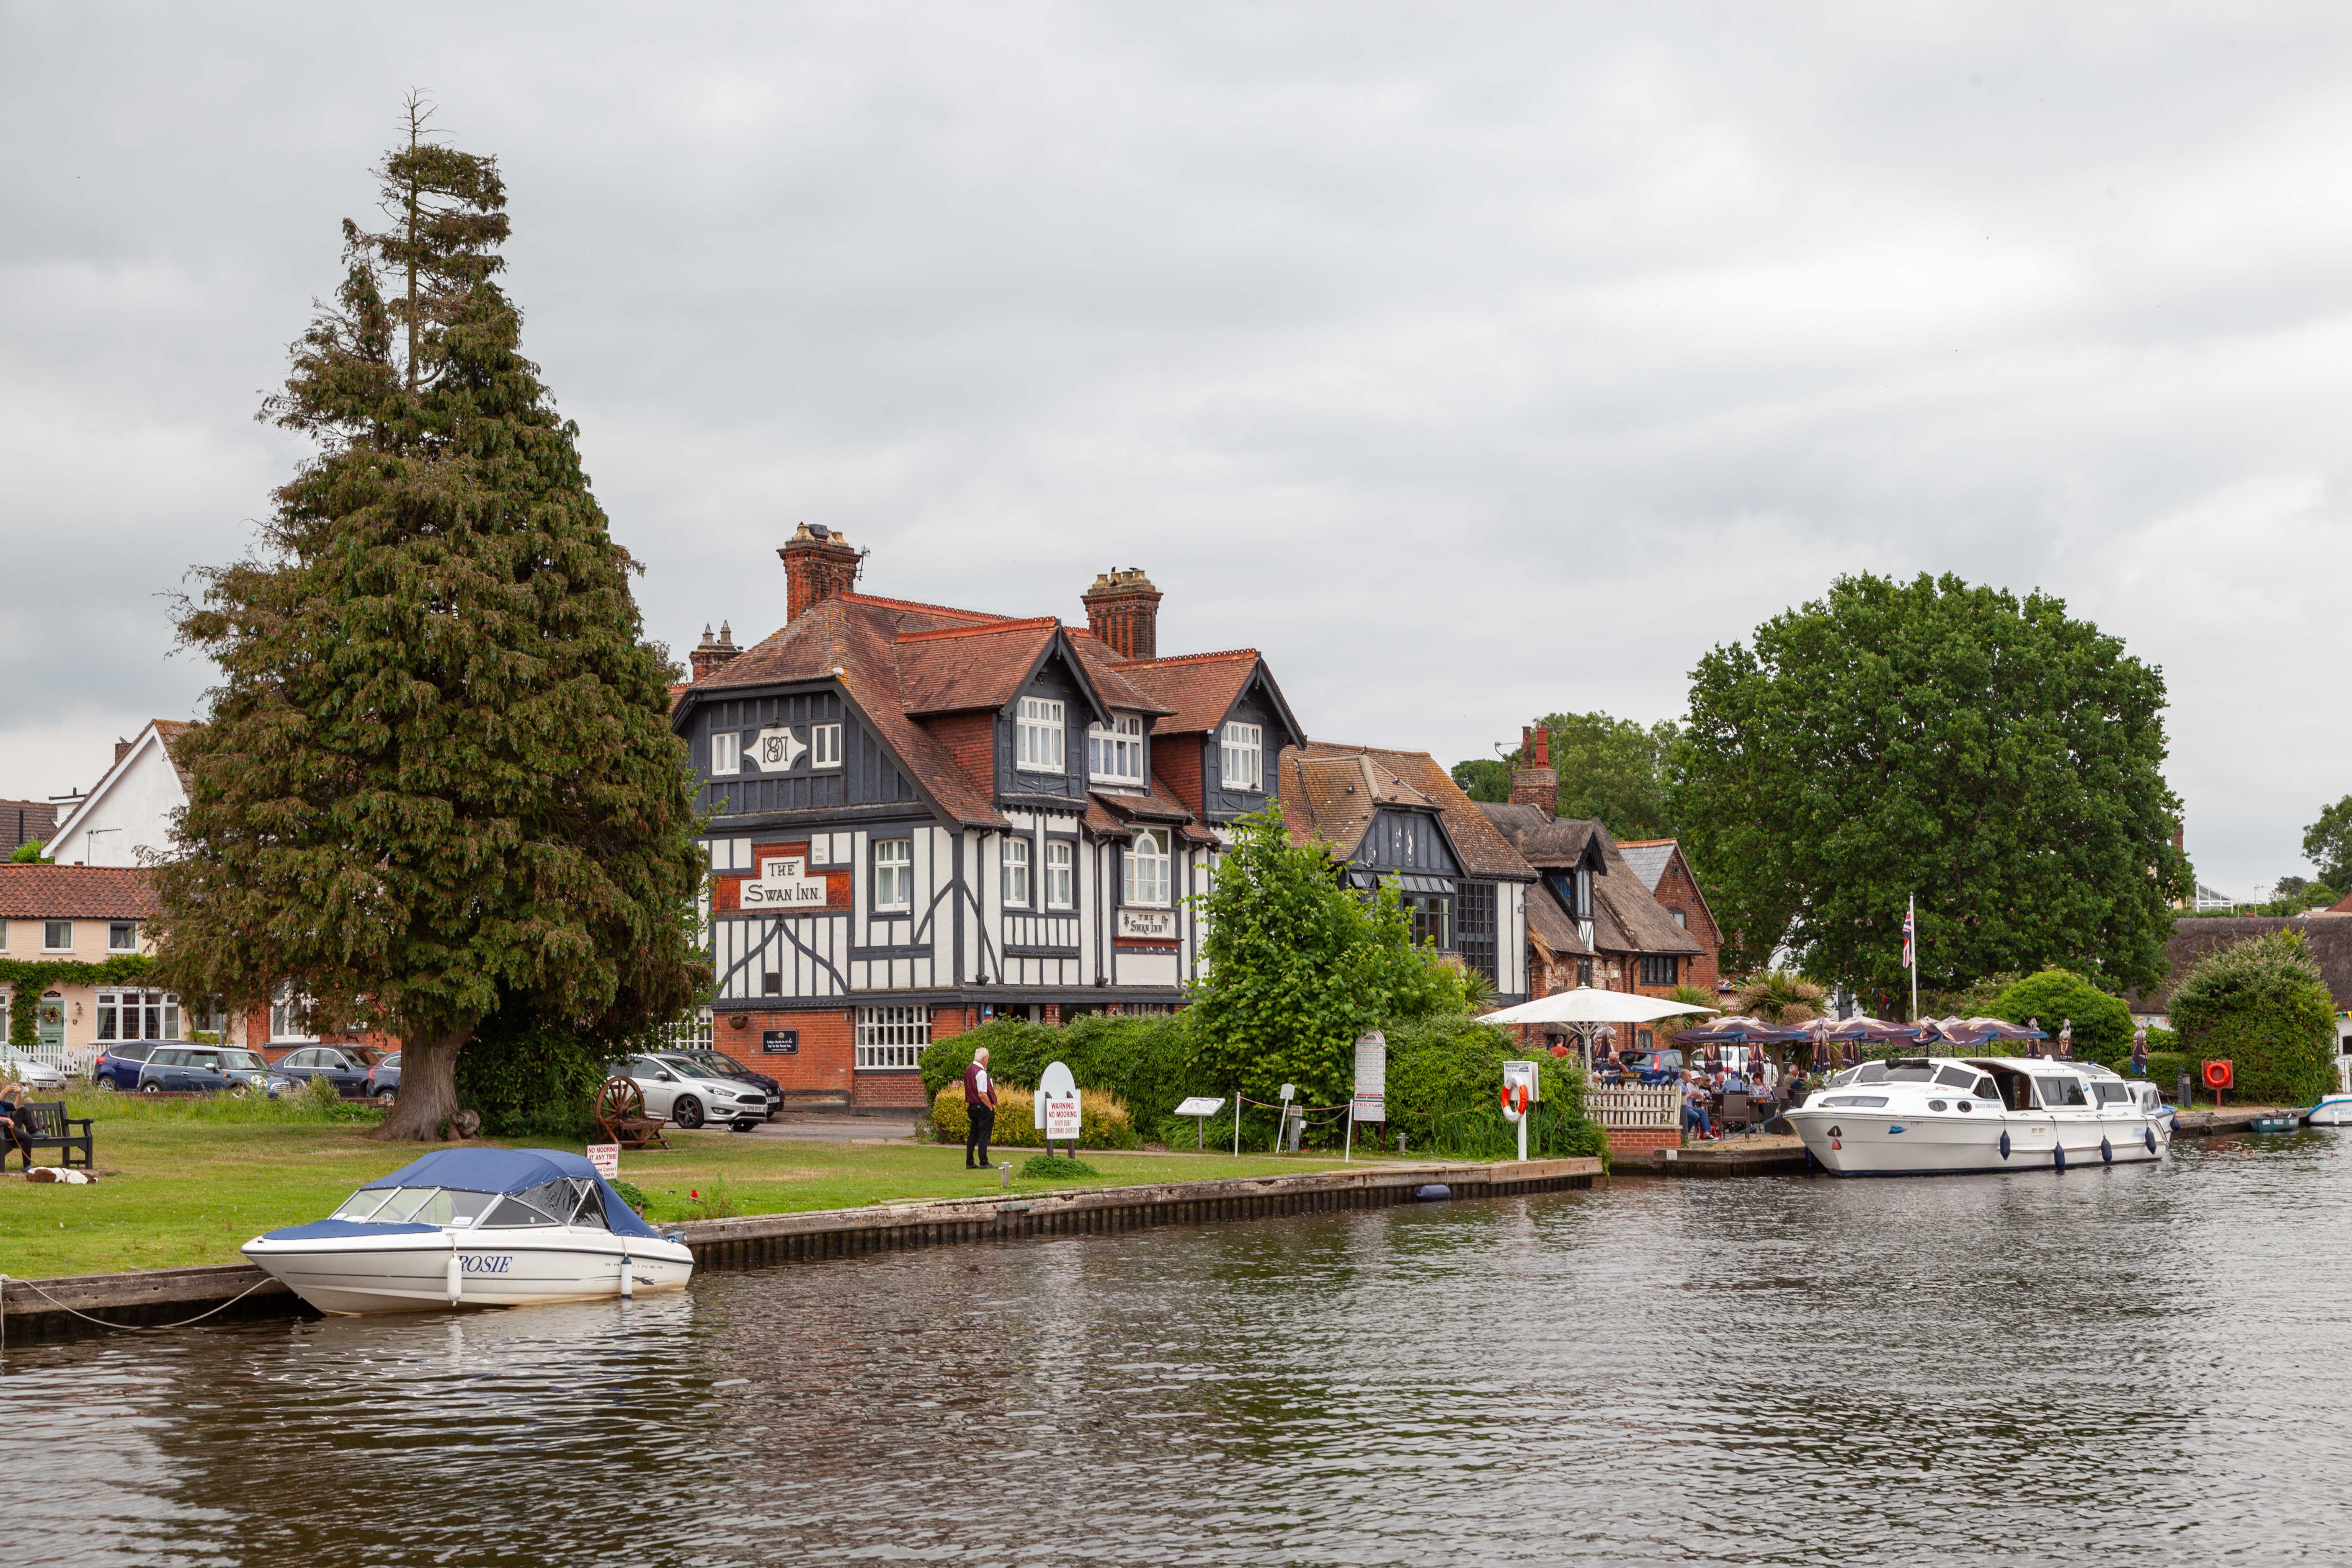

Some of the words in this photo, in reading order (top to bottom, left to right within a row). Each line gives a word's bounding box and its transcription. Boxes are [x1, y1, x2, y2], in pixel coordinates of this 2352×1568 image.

[762, 736, 788, 763] 1897
[768, 860, 799, 877] THE
[745, 884, 792, 902] SWAN
[1130, 920, 1149, 934] SWAN
[1150, 921, 1163, 932] INN
[459, 1256, 513, 1273] ROSIE
